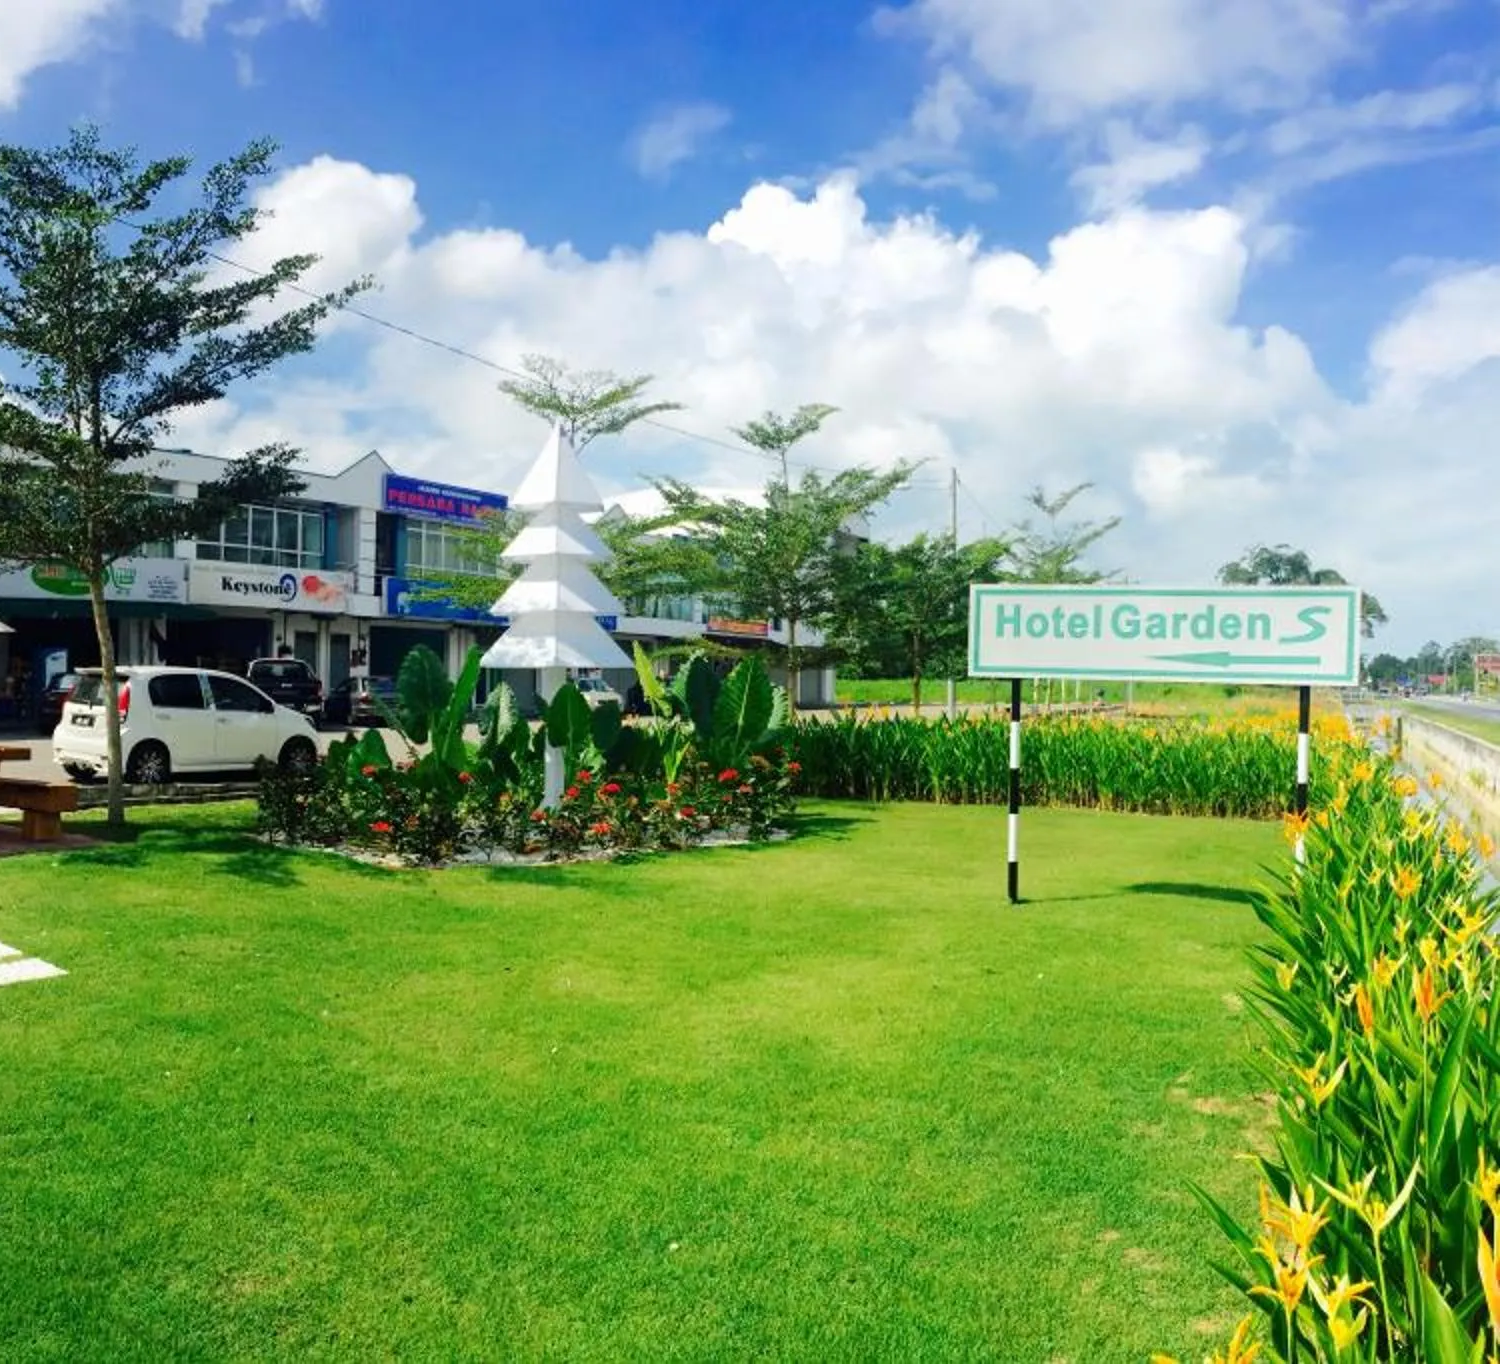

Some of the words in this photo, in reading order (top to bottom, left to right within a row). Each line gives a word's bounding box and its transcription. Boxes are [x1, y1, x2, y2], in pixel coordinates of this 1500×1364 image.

[221, 575, 291, 596] Keystone
[996, 604, 1101, 639] Hotel
[1110, 603, 1271, 640] Garden
